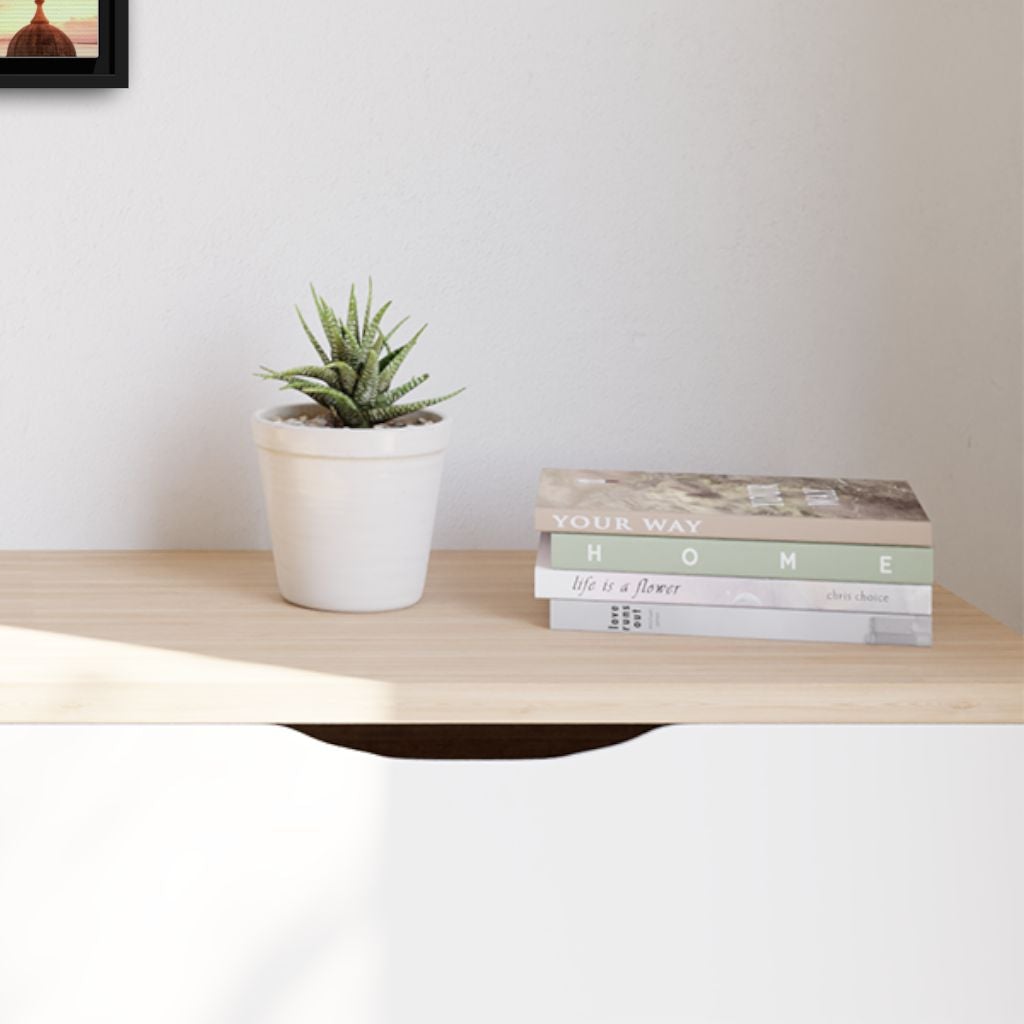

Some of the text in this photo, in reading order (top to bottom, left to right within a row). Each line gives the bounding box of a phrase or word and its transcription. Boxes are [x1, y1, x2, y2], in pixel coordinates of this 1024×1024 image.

[552, 514, 703, 533] YOUR WAY
[586, 543, 893, 574] HOME
[571, 575, 681, 599] life is a flower
[826, 588, 889, 603] chris choice
[608, 605, 619, 630] love
[622, 605, 630, 631] runs
[632, 609, 641, 629] out
